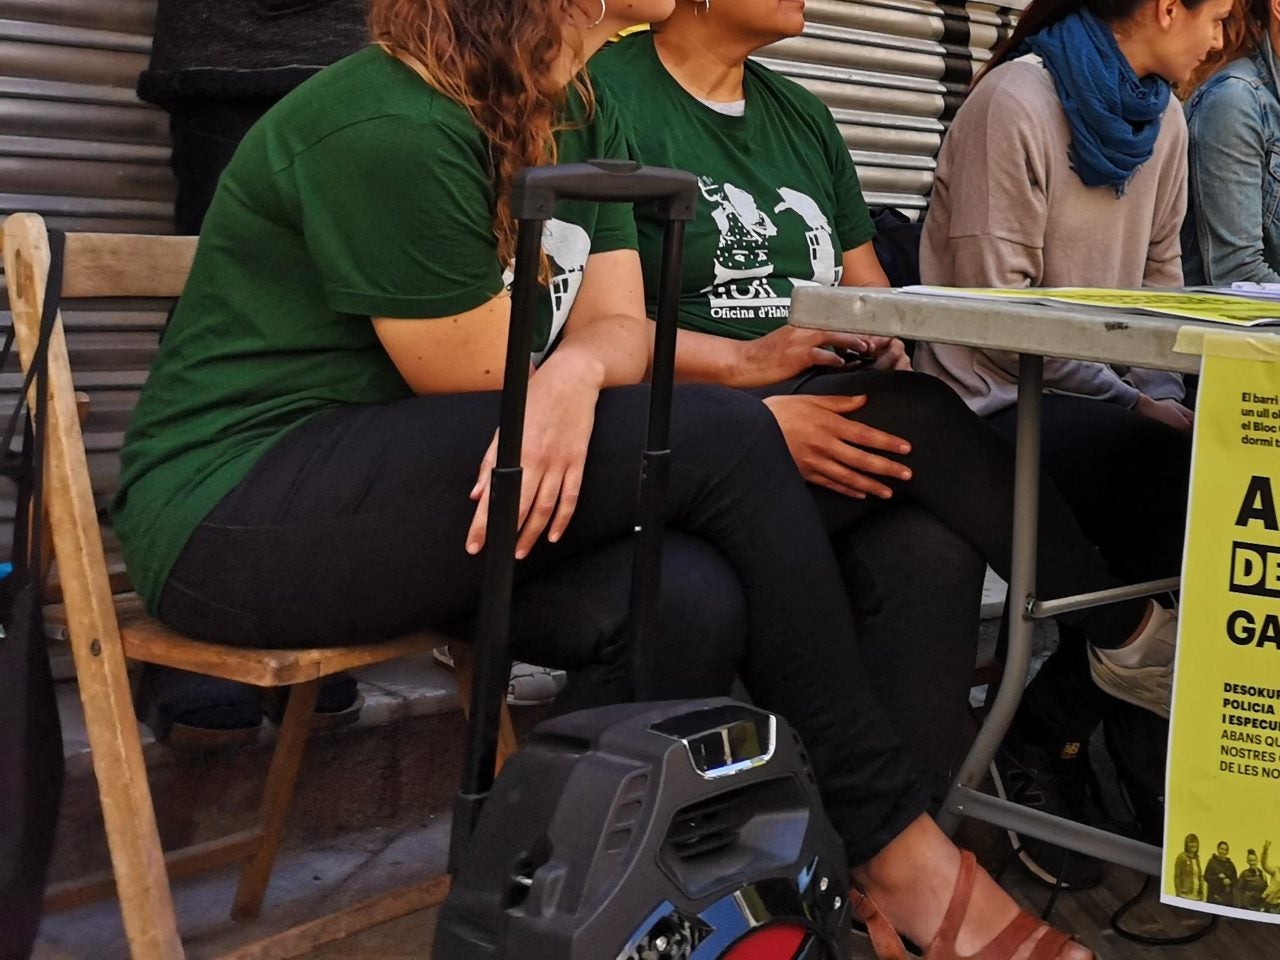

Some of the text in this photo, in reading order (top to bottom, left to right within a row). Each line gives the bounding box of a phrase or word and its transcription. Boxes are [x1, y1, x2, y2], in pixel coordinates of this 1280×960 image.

[711, 308, 754, 318] Oficina
[1242, 392, 1251, 402] El
[1253, 394, 1278, 405] barri
[1256, 408, 1269, 418] ull
[1241, 421, 1251, 430] el
[1253, 422, 1277, 433] Bloc
[1241, 435, 1273, 445] dormi
[1223, 698, 1275, 715] POLICIA
[1222, 714, 1226, 724] I
[1221, 730, 1262, 745] ABANS
[1221, 745, 1276, 762] NOSTRES
[1220, 761, 1234, 773] DE
[1237, 764, 1259, 776] LES
